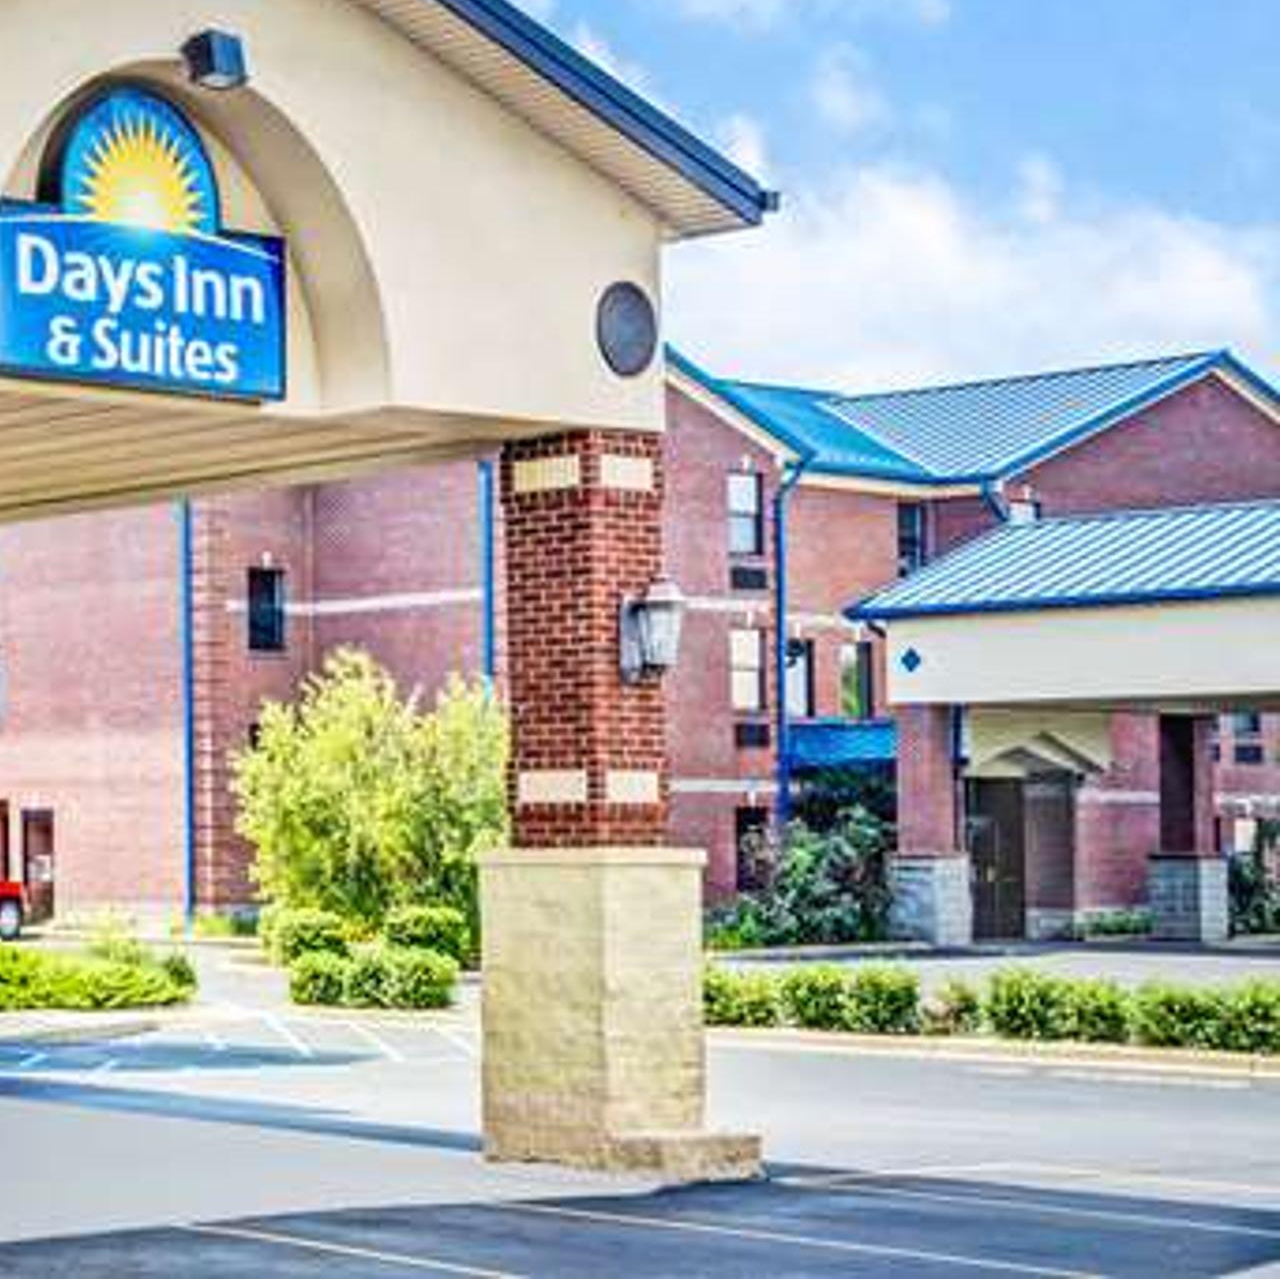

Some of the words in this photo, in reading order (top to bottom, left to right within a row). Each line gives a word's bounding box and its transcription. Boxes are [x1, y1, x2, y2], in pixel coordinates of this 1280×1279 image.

[15, 232, 164, 314] Days
[174, 254, 265, 323] Inn
[46, 315, 82, 366] &
[92, 317, 238, 382] Suites
